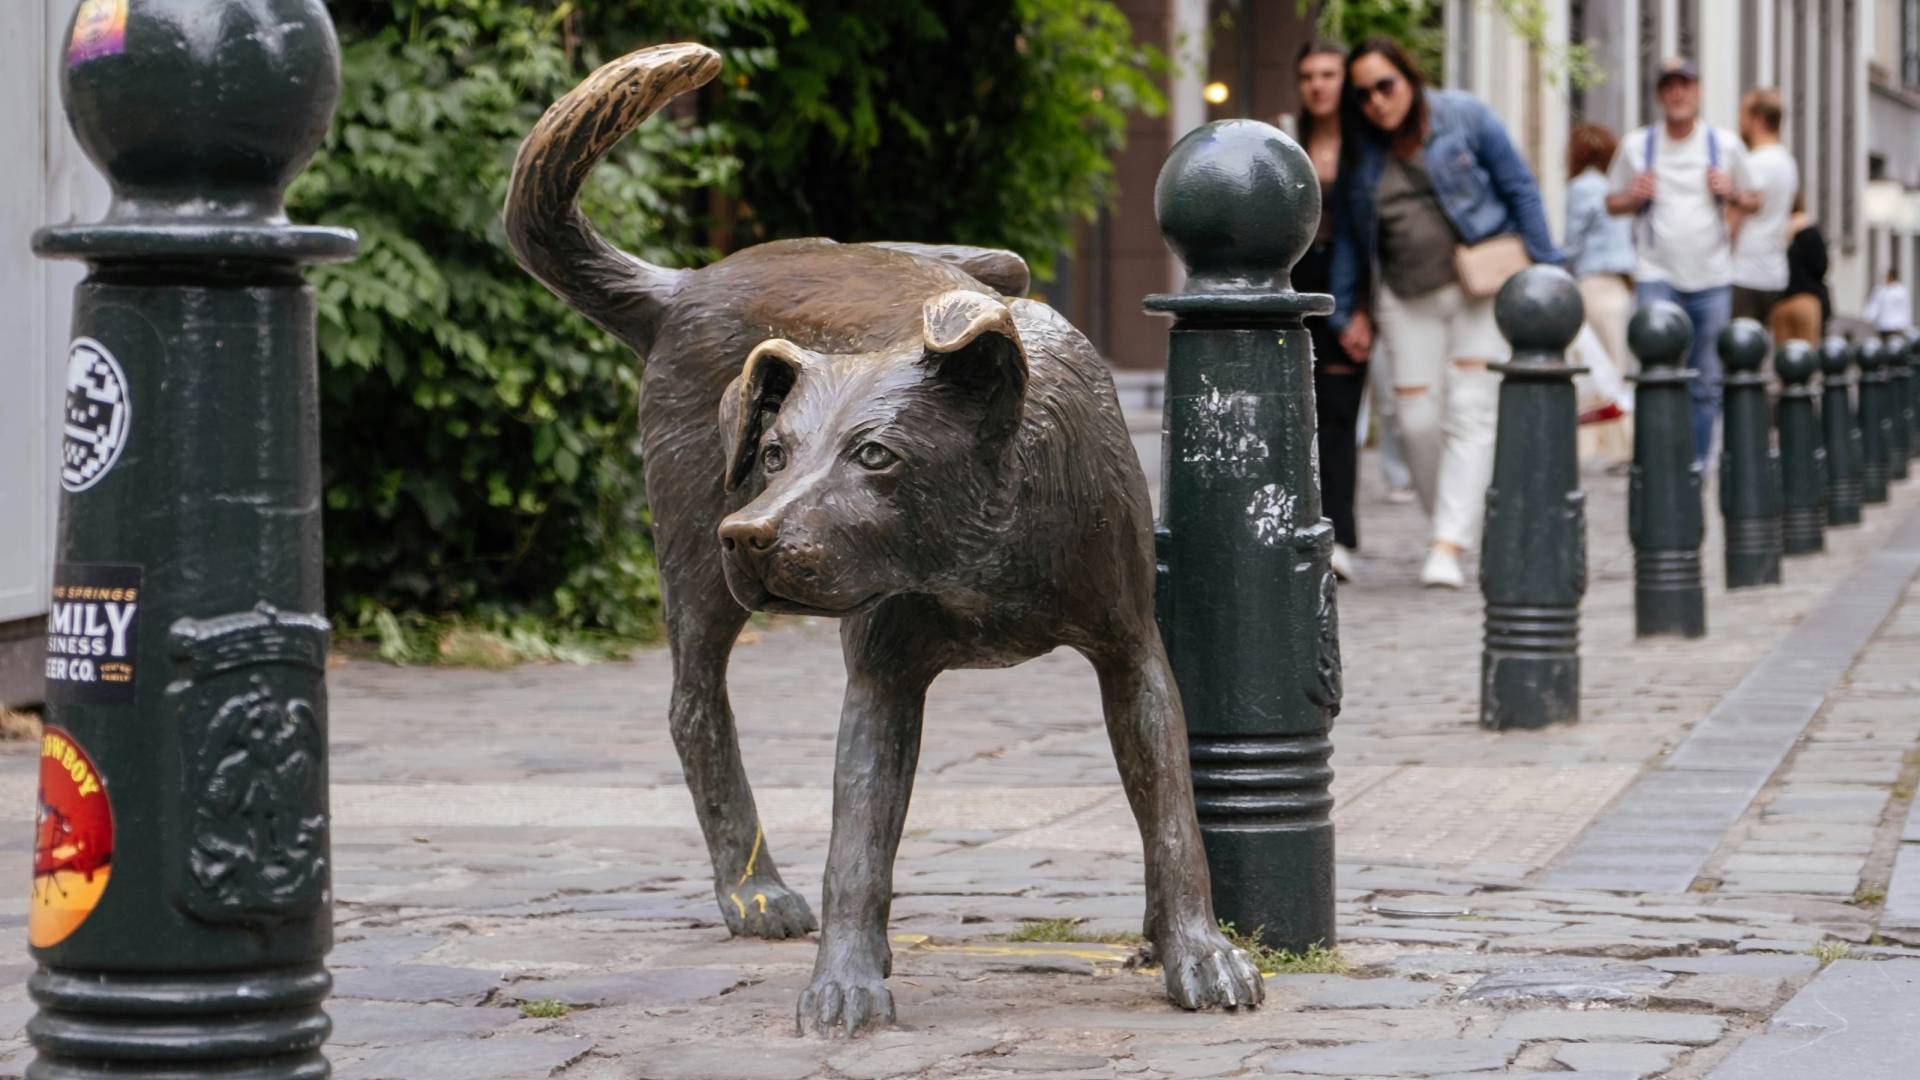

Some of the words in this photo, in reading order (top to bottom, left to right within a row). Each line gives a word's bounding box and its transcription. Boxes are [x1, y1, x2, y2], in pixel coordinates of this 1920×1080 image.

[67, 586, 137, 601] SPRINGS
[49, 602, 137, 657] MILY
[69, 658, 97, 682] CO.
[101, 673, 131, 683] FAMILY
[41, 734, 100, 797] OWBOY
